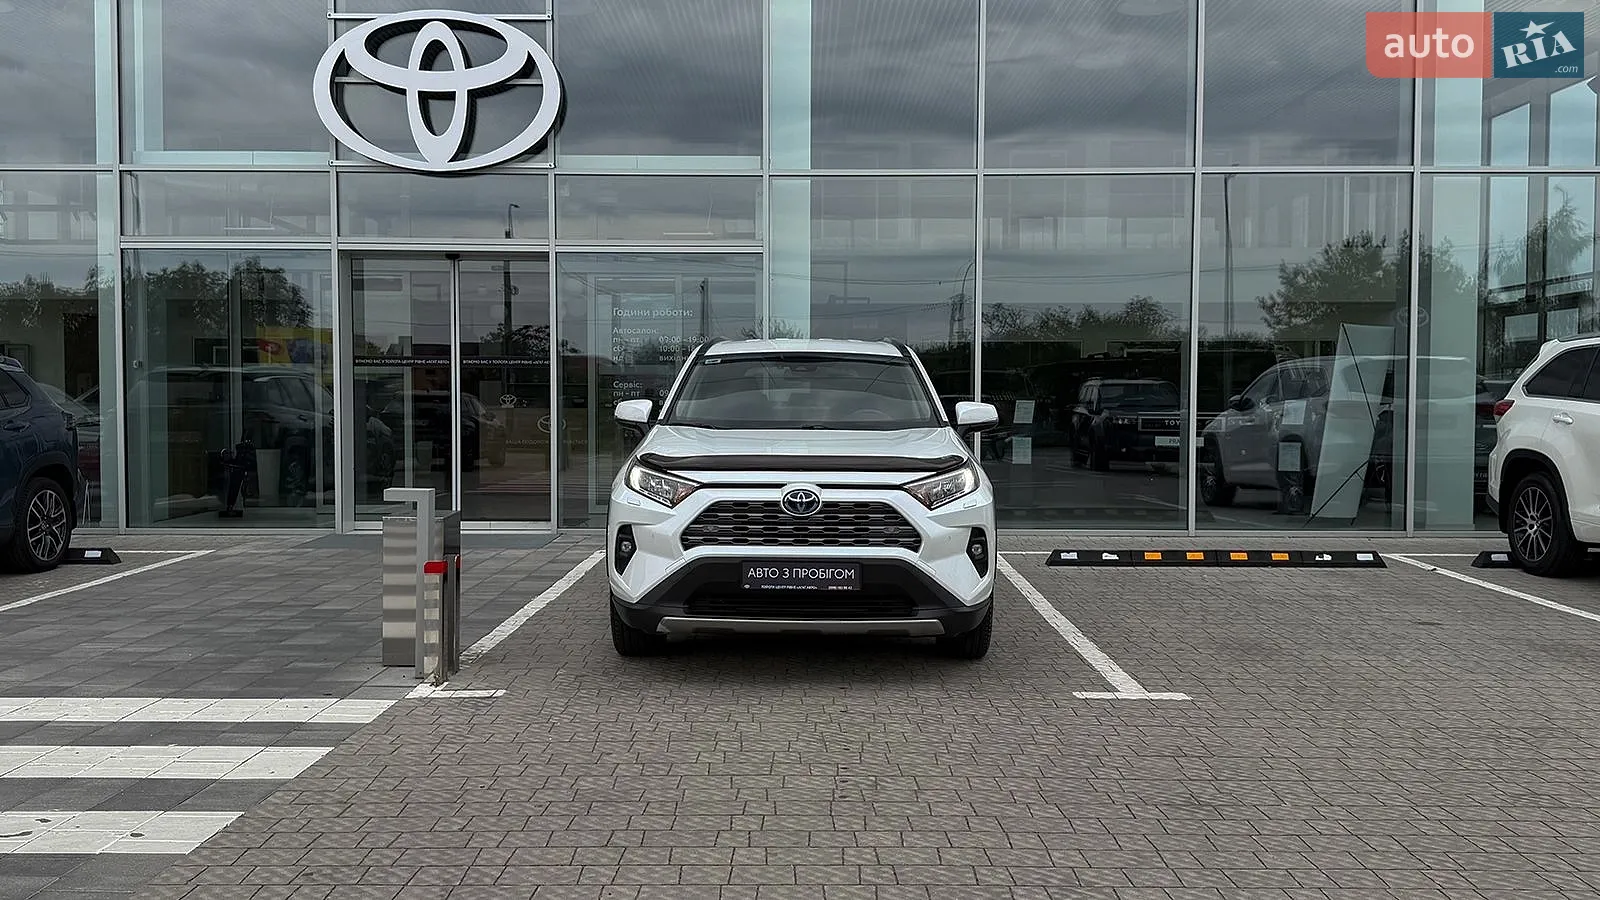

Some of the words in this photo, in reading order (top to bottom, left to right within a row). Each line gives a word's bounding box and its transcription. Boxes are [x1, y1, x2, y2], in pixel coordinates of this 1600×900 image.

[613, 307, 650, 318] Години
[652, 308, 693, 318] роботи:
[613, 380, 643, 390] Сервіс:
[747, 567, 779, 579] АВТО
[793, 568, 855, 580] ПРОБІГОМ
